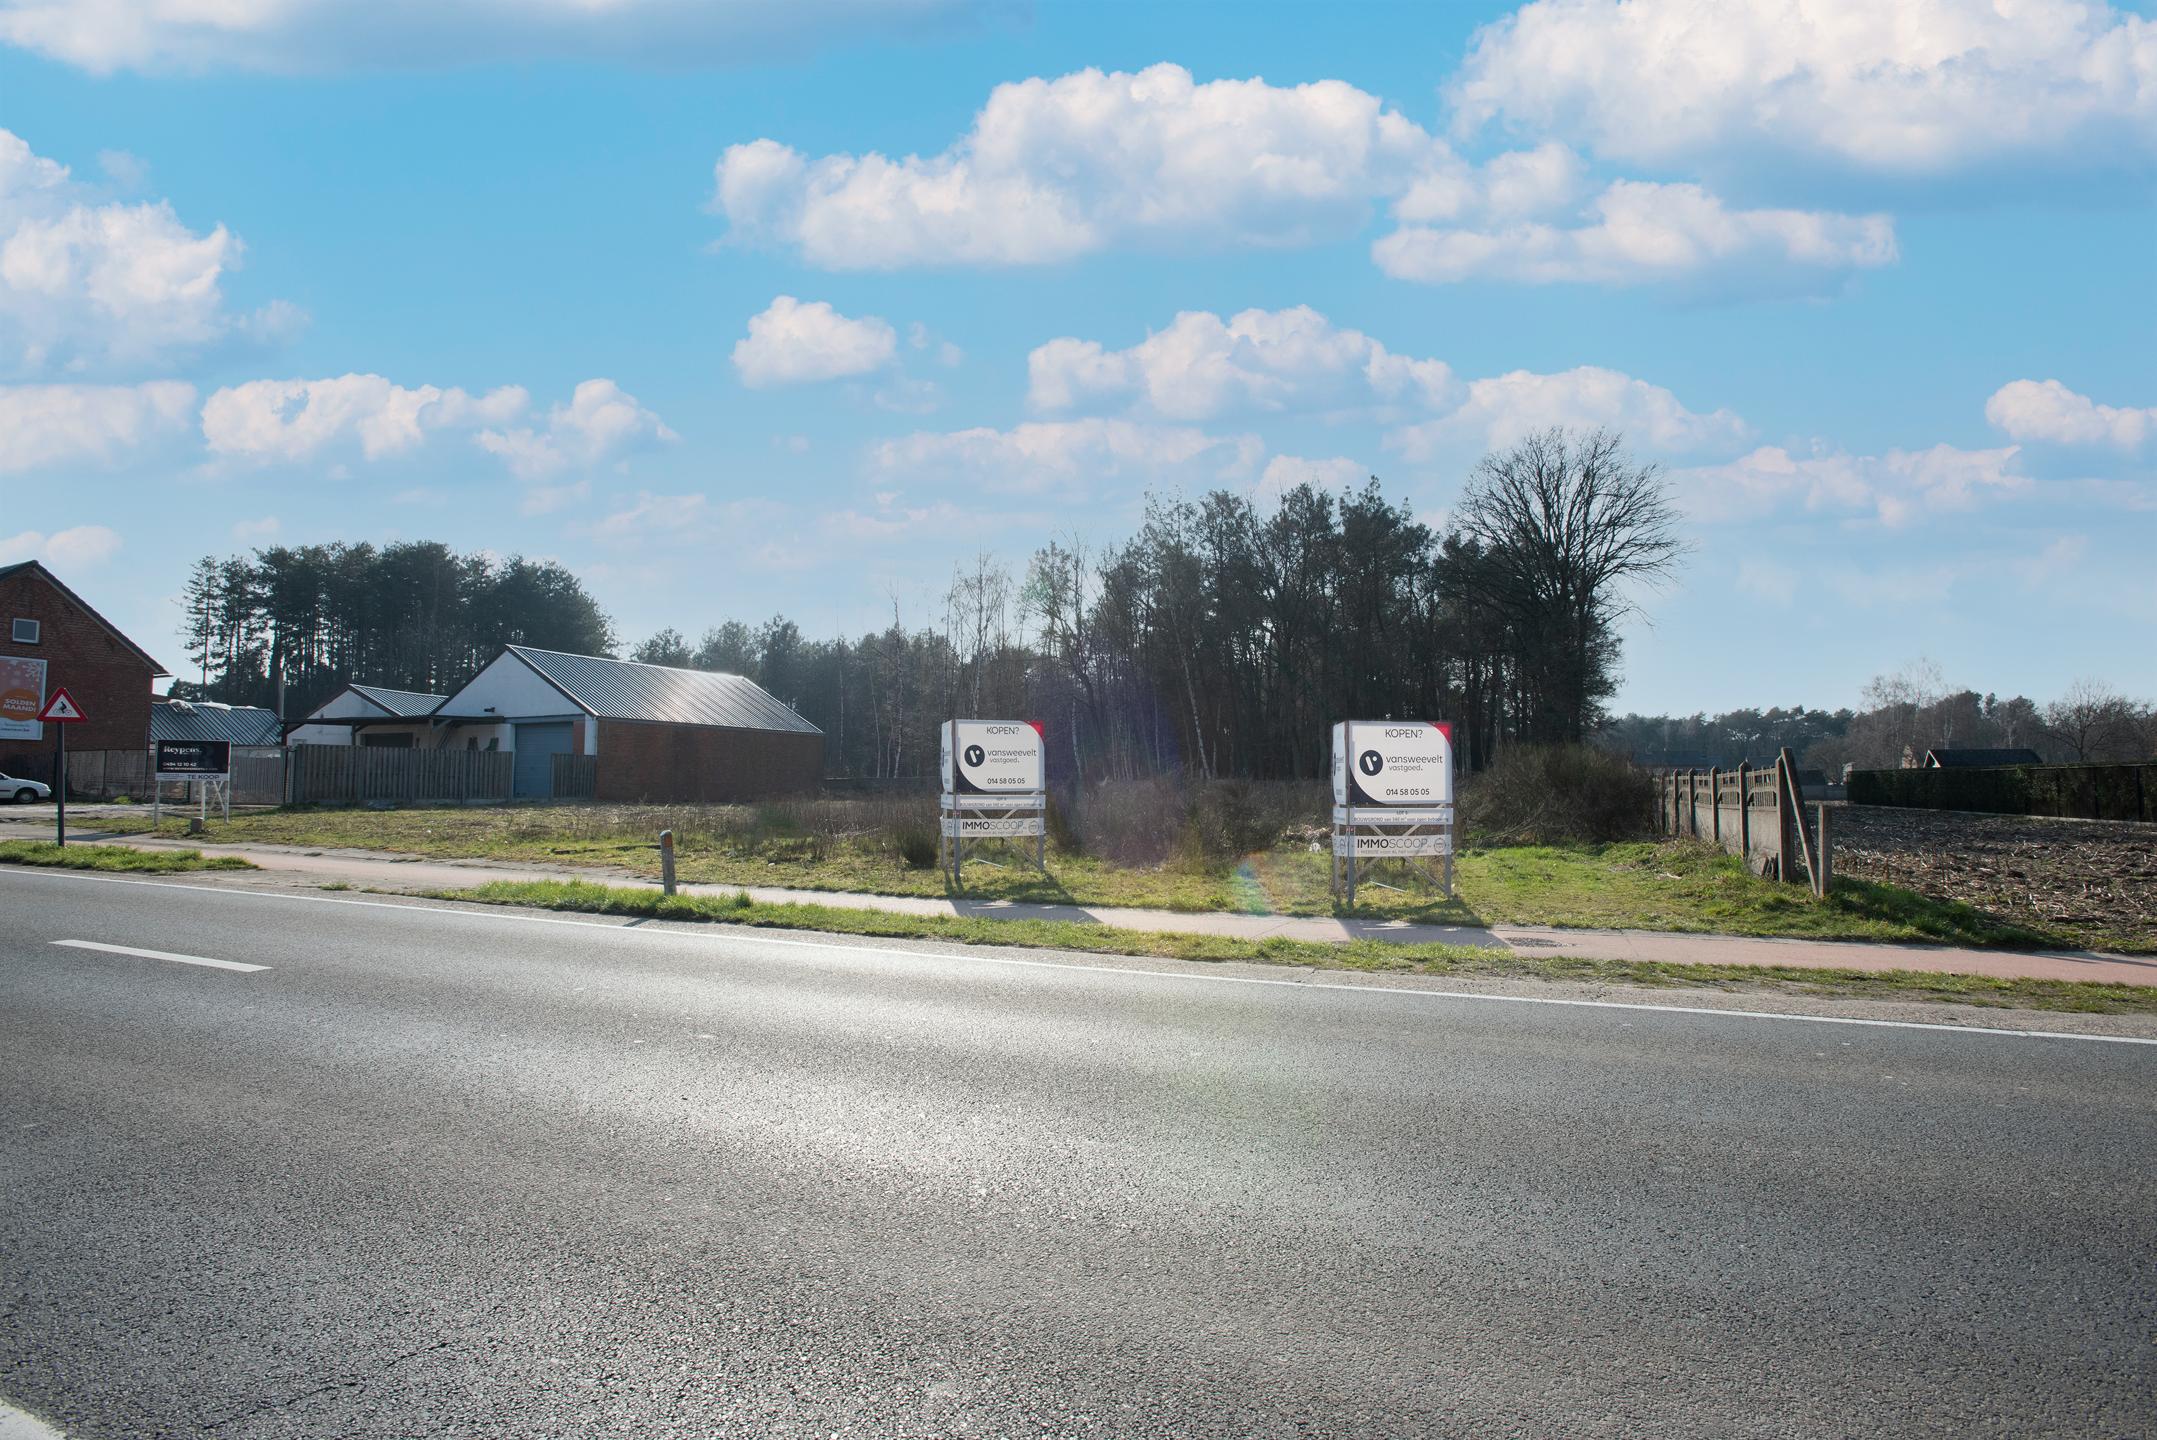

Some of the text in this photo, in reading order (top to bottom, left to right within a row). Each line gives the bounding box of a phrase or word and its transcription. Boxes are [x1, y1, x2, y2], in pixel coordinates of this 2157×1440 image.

[5, 698, 36, 706] SOLDEN
[986, 726, 1020, 735] KOPEN?
[1385, 729, 1423, 738] KOPEN?
[987, 748, 1037, 757] vansweevelt
[1386, 755, 1443, 764] vansweevelt
[1389, 764, 1424, 772] vastgoed.
[1386, 788, 1430, 796] 014 58 05 05
